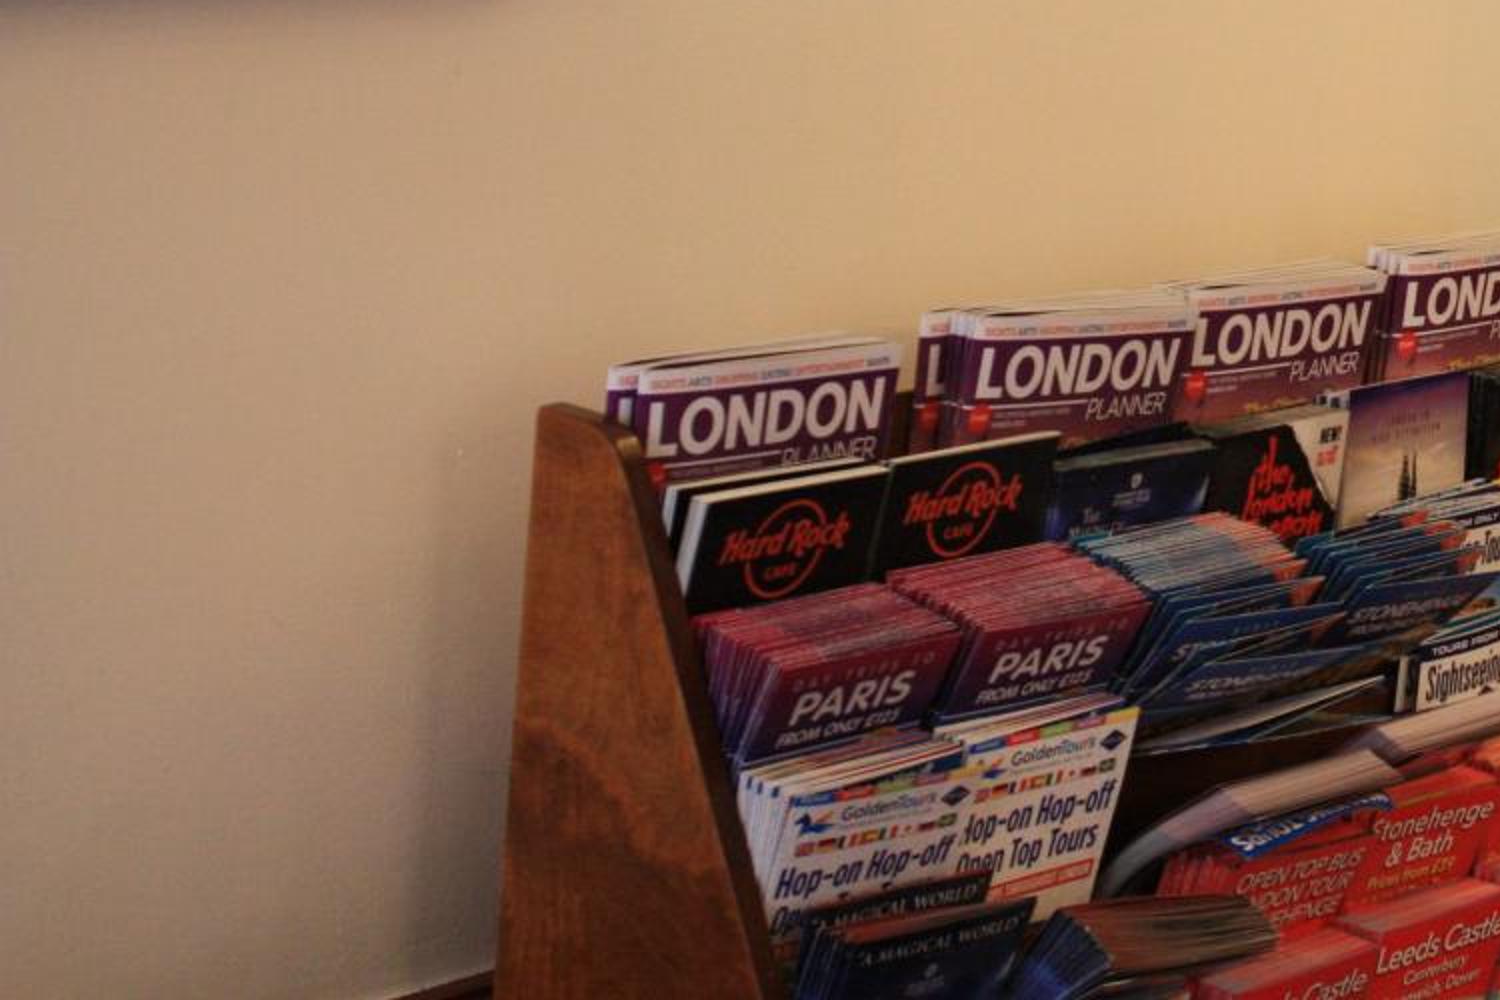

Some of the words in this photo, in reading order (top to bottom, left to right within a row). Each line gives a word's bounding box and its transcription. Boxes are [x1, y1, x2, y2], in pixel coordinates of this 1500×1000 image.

[1190, 301, 1372, 368] LONDON
[975, 337, 1181, 400] LONDON
[1289, 352, 1360, 384] PLANNER
[645, 376, 887, 459] LONDON
[1085, 391, 1167, 420] PLANNER
[781, 436, 877, 467] PLANNER
[904, 485, 968, 526] Hard
[966, 474, 1024, 518] Rock
[719, 523, 791, 565] Hard
[789, 511, 851, 558] Rock
[988, 634, 1109, 685] PARIS
[788, 668, 916, 727] PARIS
[975, 685, 1019, 706] FROM
[1020, 677, 1058, 697] ONLY
[775, 725, 823, 750] FROM
[823, 717, 861, 738] ONLY
[1036, 780, 1118, 826] Hop-off
[1373, 802, 1495, 840] Stonehenge
[774, 858, 865, 900] Hop-on
[865, 834, 957, 880] Hop-off
[1009, 837, 1043, 869] Top
[1048, 824, 1099, 857] Tours
[1385, 842, 1402, 867] &
[1407, 830, 1453, 861] Bath
[1376, 931, 1441, 975] Leeds
